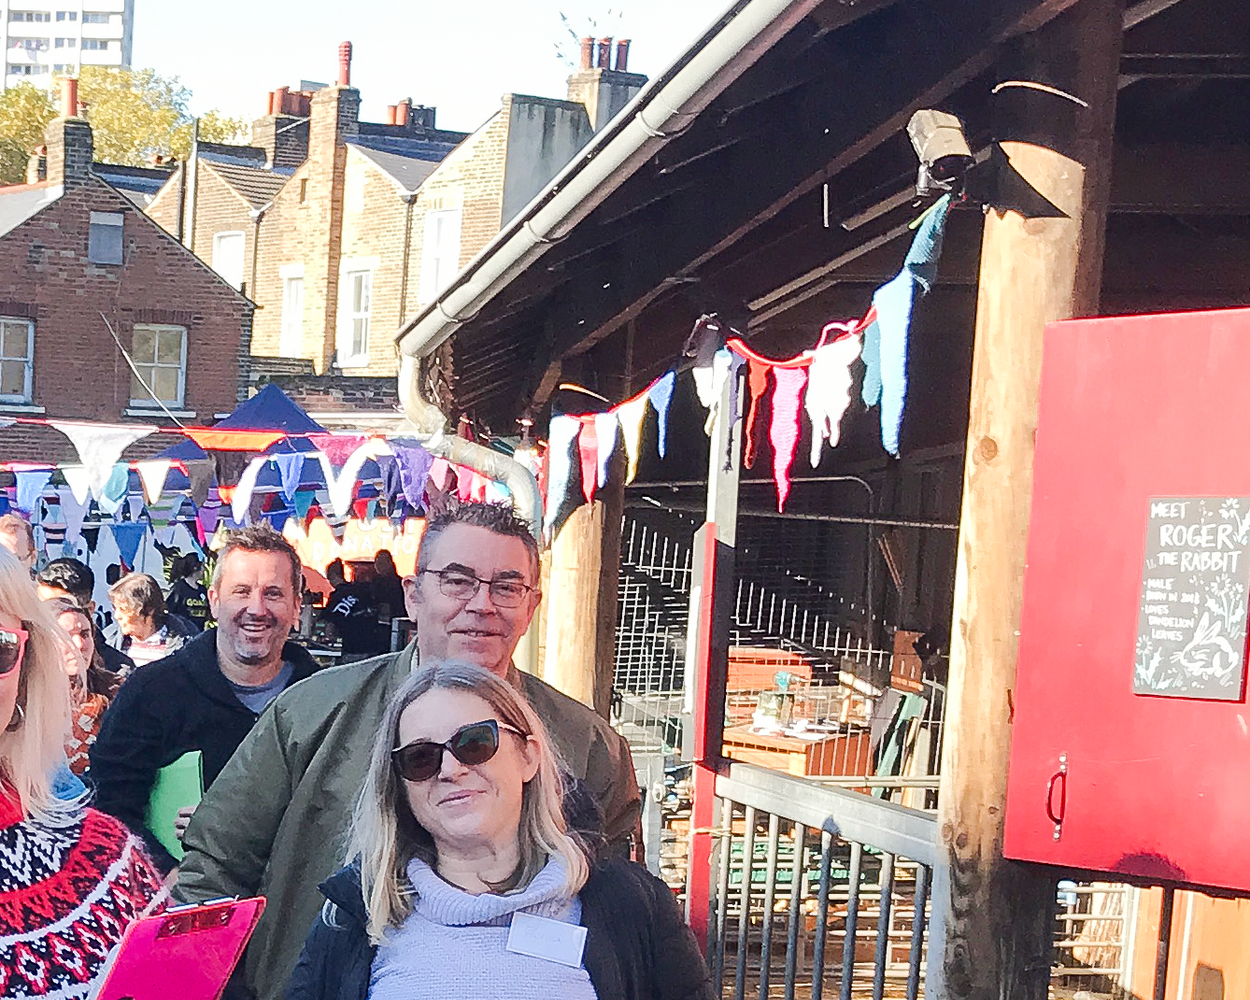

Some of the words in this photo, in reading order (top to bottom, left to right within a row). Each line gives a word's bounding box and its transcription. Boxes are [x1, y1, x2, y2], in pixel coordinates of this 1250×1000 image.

[1151, 501, 1190, 519] MEET
[1160, 523, 1234, 549] ROGER
[1157, 552, 1178, 566] THE
[1180, 551, 1242, 573] RABBIT
[1147, 578, 1175, 590] MALE
[1145, 604, 1169, 615] LOVES
[1148, 615, 1194, 628] DANDELION
[1151, 628, 1183, 642] LEAVES
